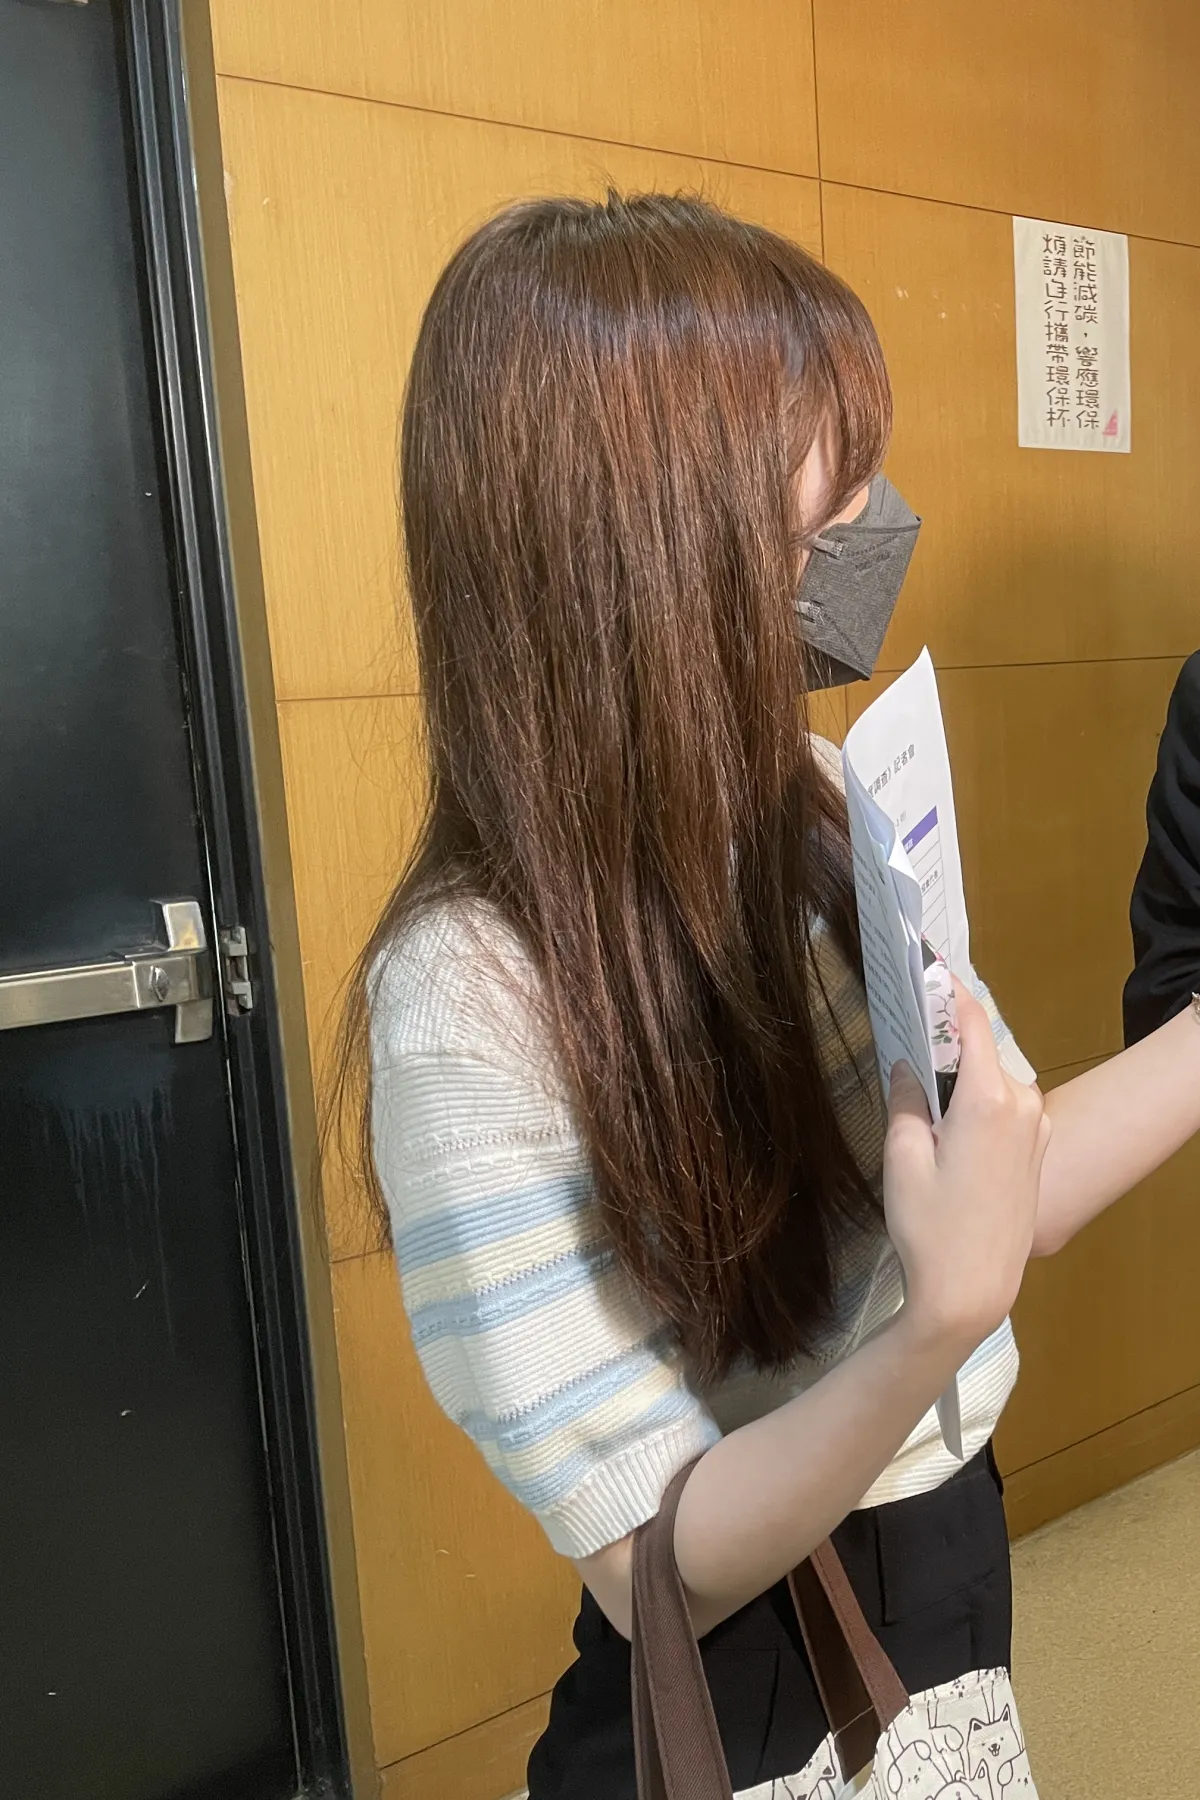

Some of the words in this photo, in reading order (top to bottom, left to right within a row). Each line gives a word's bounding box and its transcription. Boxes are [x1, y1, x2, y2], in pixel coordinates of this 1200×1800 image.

[1041, 233, 1071, 428] 煩請自行攜帶環保杯
